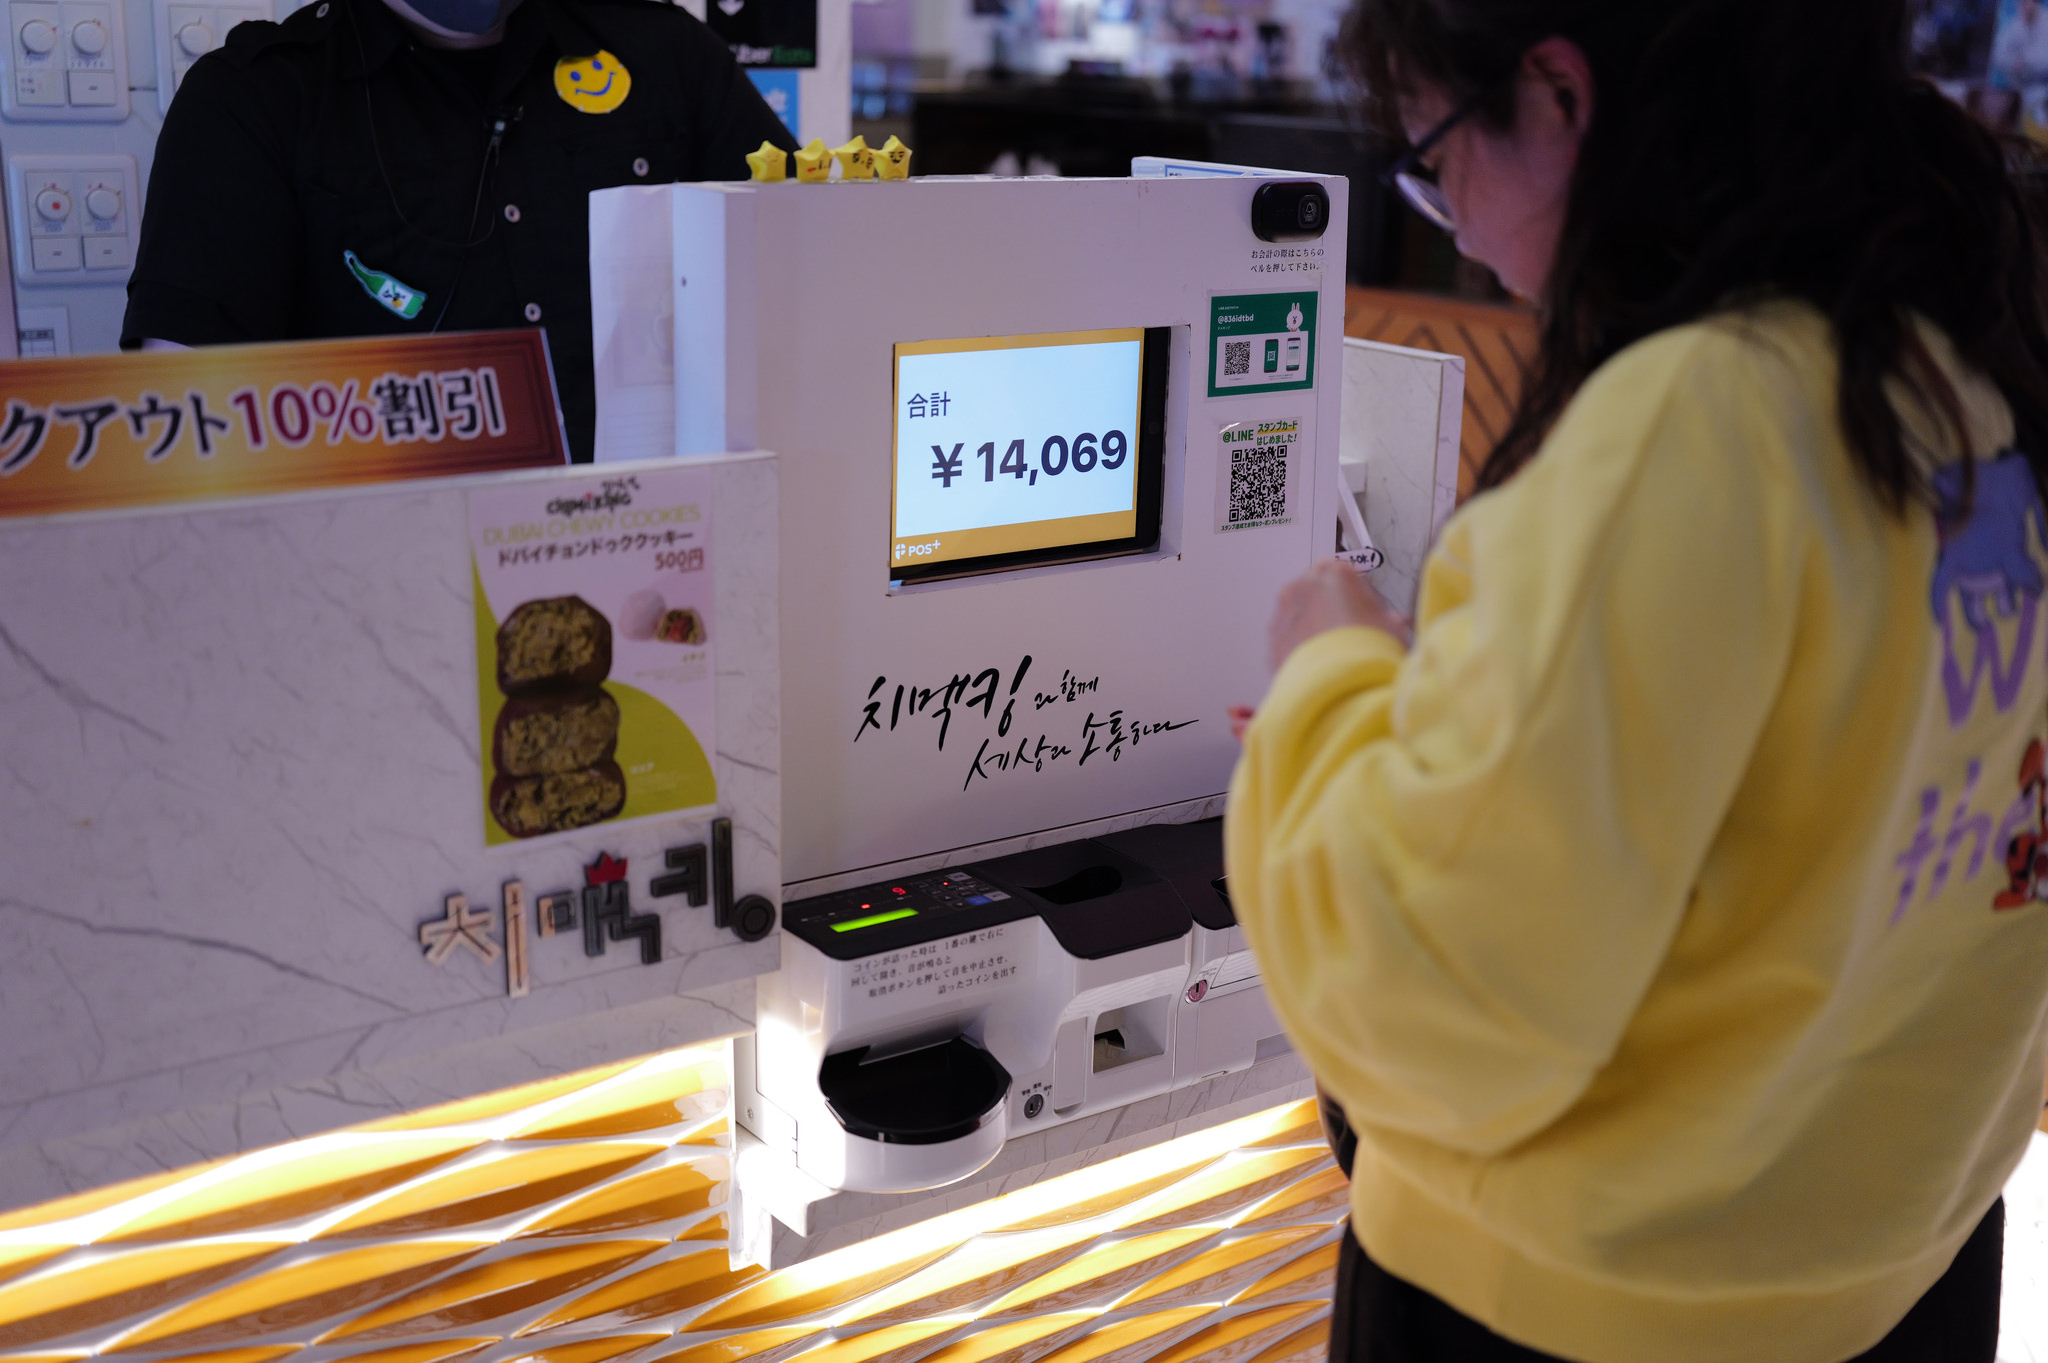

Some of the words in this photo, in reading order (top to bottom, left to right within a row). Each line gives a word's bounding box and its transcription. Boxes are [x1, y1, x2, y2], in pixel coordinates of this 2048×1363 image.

[1251, 248, 1325, 259] お会計の際はこちらの
[1250, 262, 1320, 273] ベルを押して下さい。
[1217, 313, 1254, 324] @836idtbd
[907, 391, 951, 419] 合計
[1222, 429, 1254, 443] @LINE
[1258, 420, 1298, 433] スタンプカード
[483, 523, 544, 546] DUBAI
[547, 514, 616, 537] CHEWY
[620, 503, 700, 530] COOKIES
[655, 547, 704, 571] 500円
[964, 735, 1072, 791] 세상과
[1078, 710, 1200, 766] 소통하다
[418, 816, 776, 998] 치맥킹
